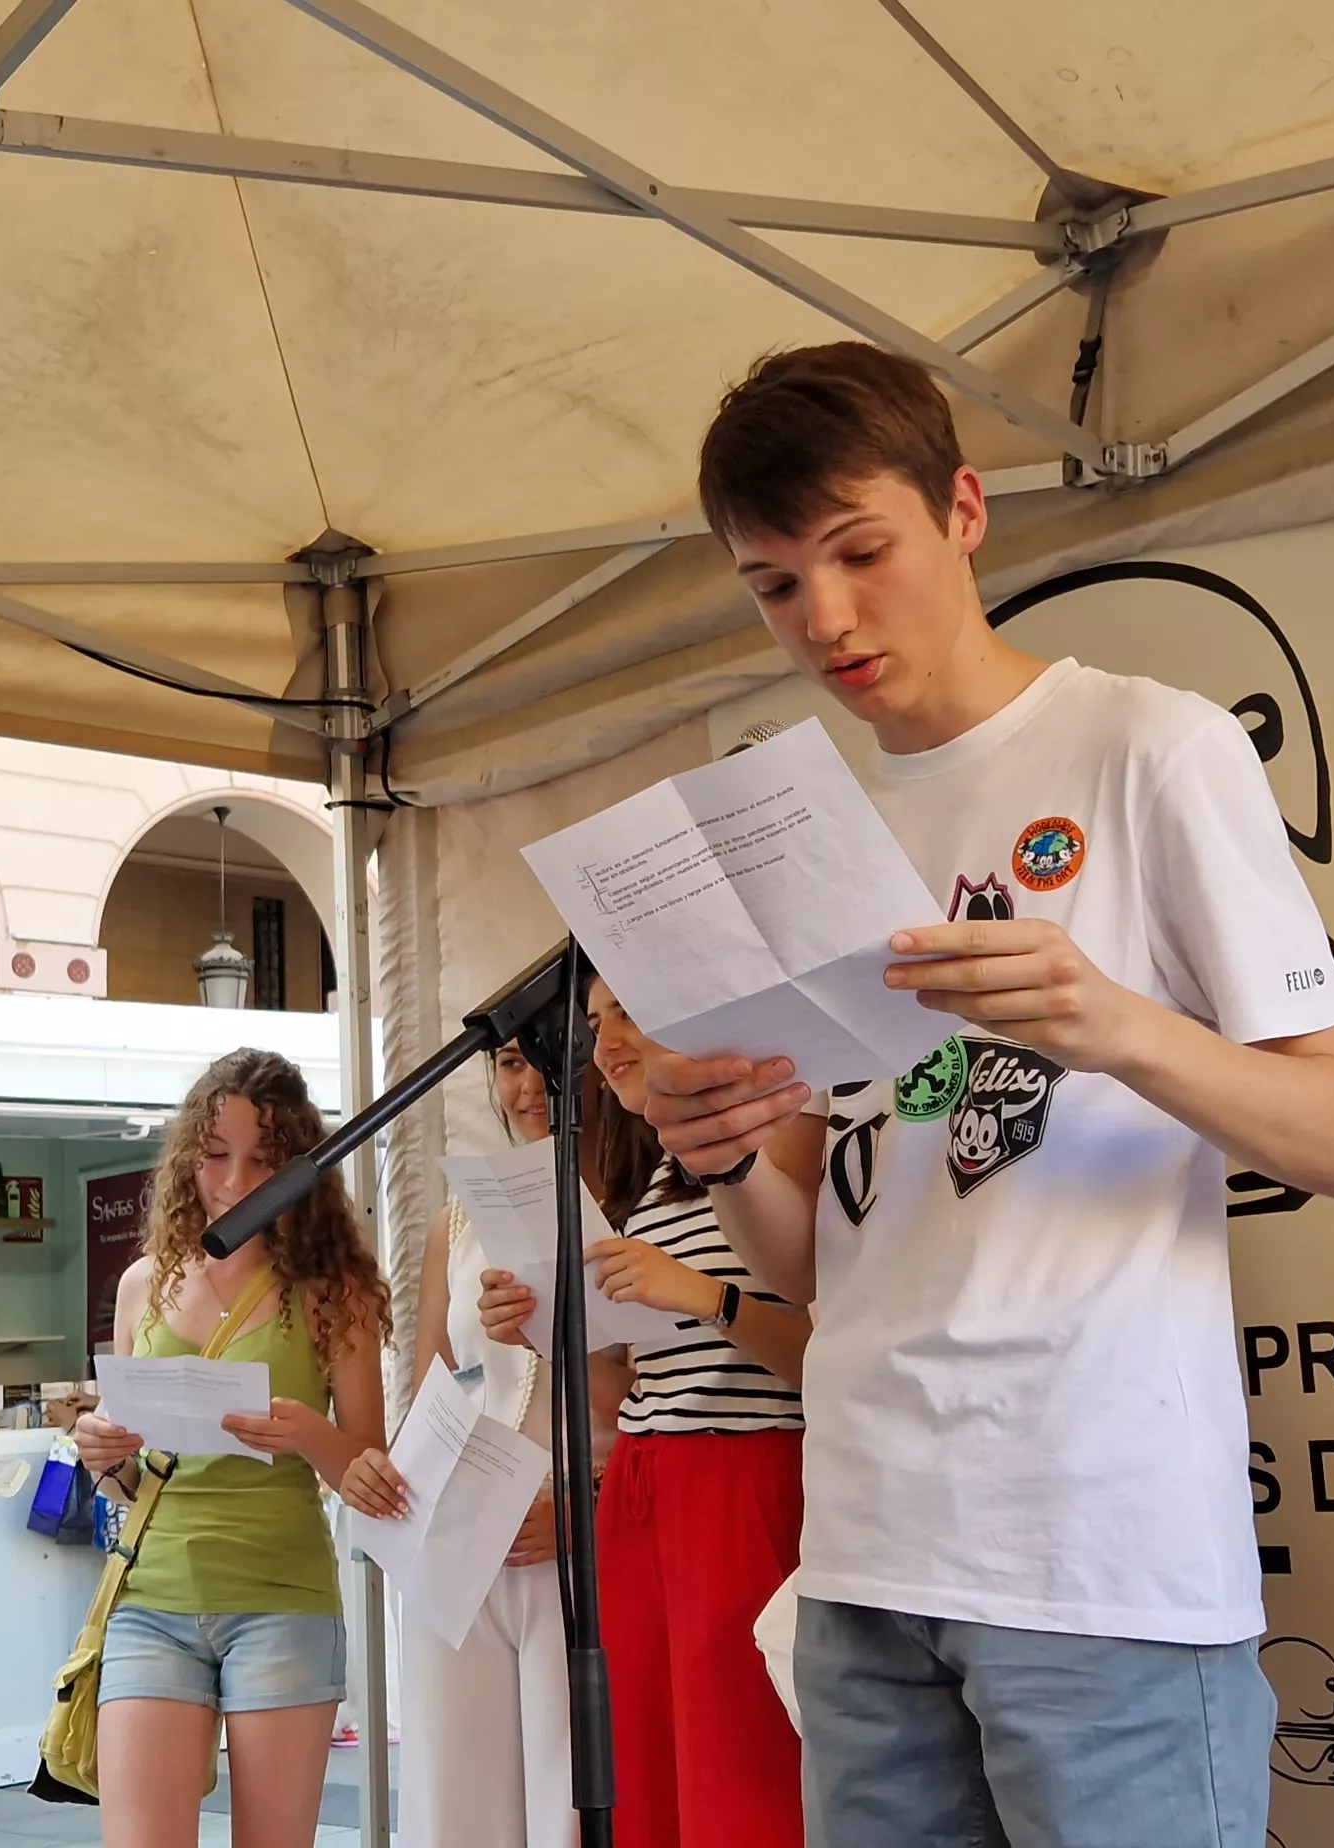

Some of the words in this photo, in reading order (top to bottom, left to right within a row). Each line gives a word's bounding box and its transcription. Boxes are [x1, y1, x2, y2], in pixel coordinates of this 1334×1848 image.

[946, 1041, 957, 1055] UP
[951, 1057, 960, 1071] TO
[969, 1049, 1047, 1094] Felix
[922, 1072, 960, 1112] SOMETHING
[1012, 1121, 1035, 1143] 1919
